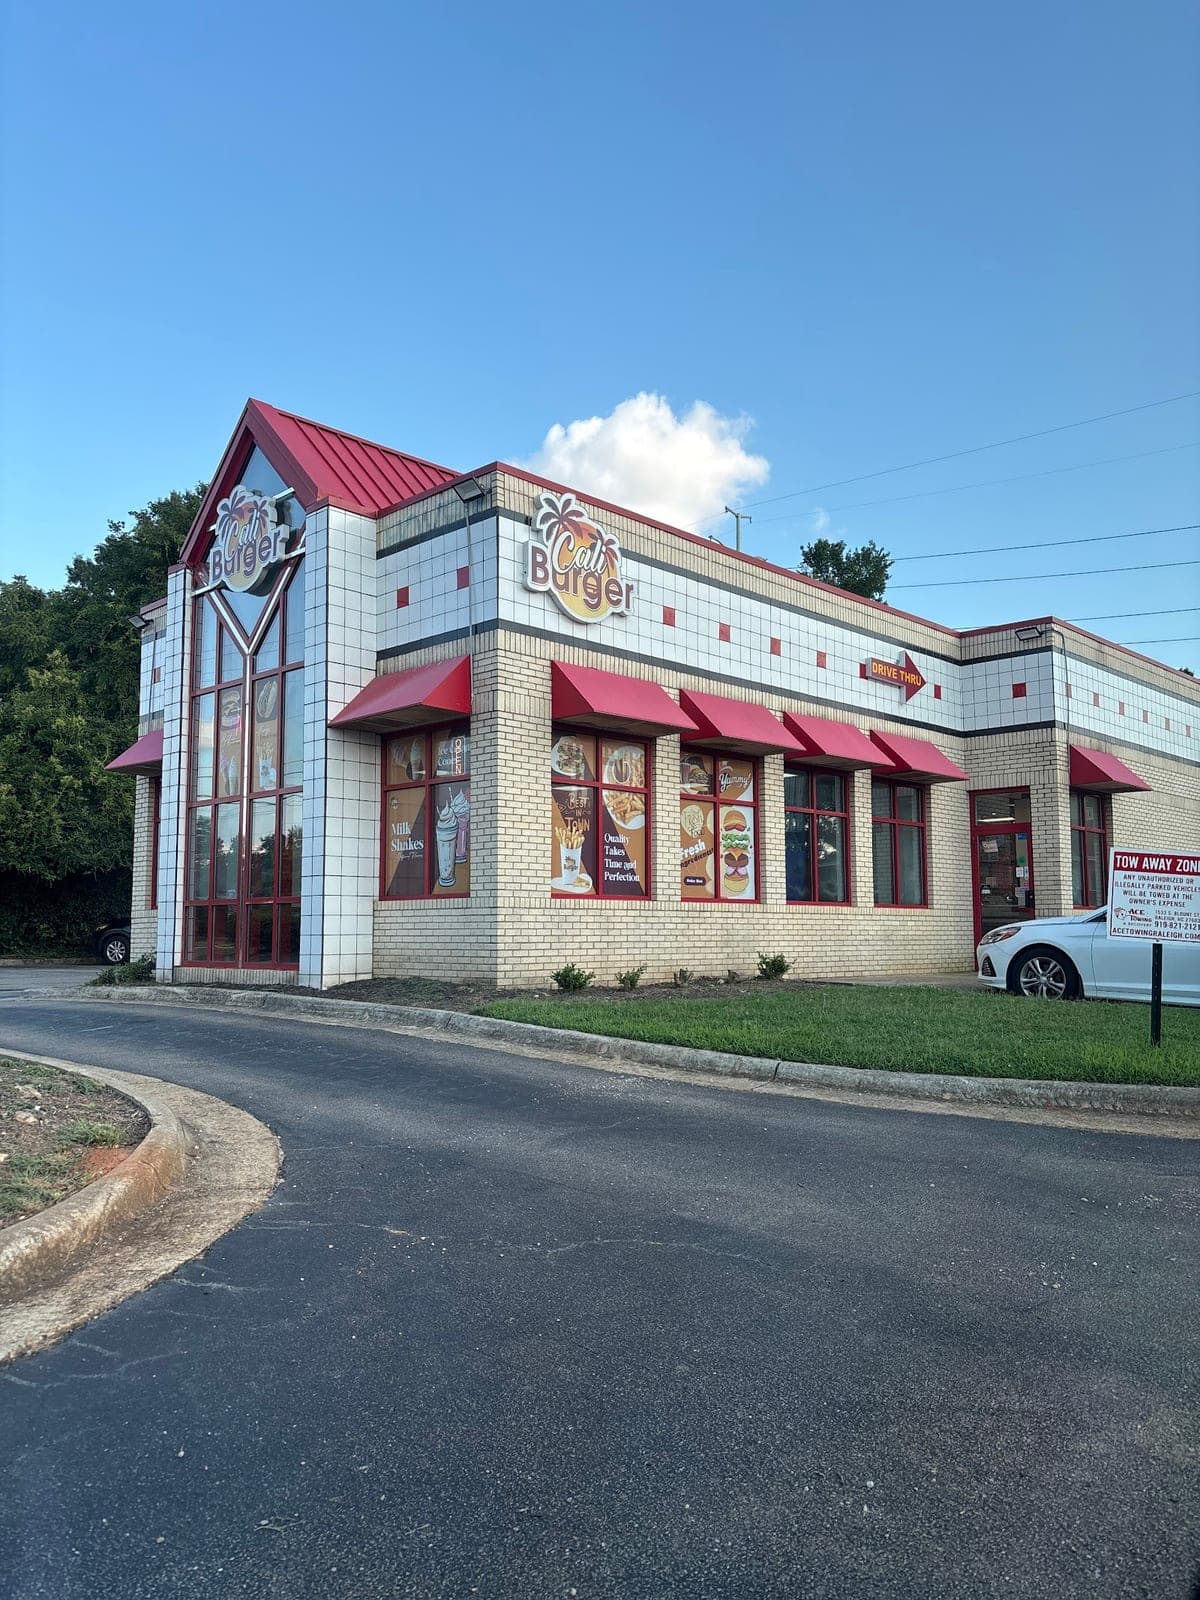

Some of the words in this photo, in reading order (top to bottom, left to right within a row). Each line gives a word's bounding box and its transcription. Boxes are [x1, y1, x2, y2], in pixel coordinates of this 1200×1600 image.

[225, 508, 260, 561] Cali
[212, 531, 281, 581] Burger
[551, 530, 609, 574] Cali
[531, 545, 634, 610] Burger
[872, 662, 898, 680] DRIVE
[900, 670, 922, 686] THRU
[575, 809, 582, 817] IN
[391, 821, 413, 835] Milk
[391, 837, 424, 851] Shakes
[604, 832, 629, 846] Quality
[604, 845, 626, 856] Takes
[603, 858, 623, 869] Time
[624, 859, 637, 870] and
[1116, 855, 1139, 869] TOW
[1142, 857, 1172, 871] AWAY
[604, 871, 641, 881] Perfection
[1138, 875, 1183, 884] UNAUTHORIZED
[1115, 881, 1145, 889] ILLEGALLY
[1147, 883, 1171, 891] PARKED
[1123, 889, 1136, 897] WILL
[1129, 898, 1157, 906] OWNER'S
[1159, 900, 1186, 908] EXPENSE
[1113, 927, 1200, 940] ACETOWINGRALEIGH.COM
